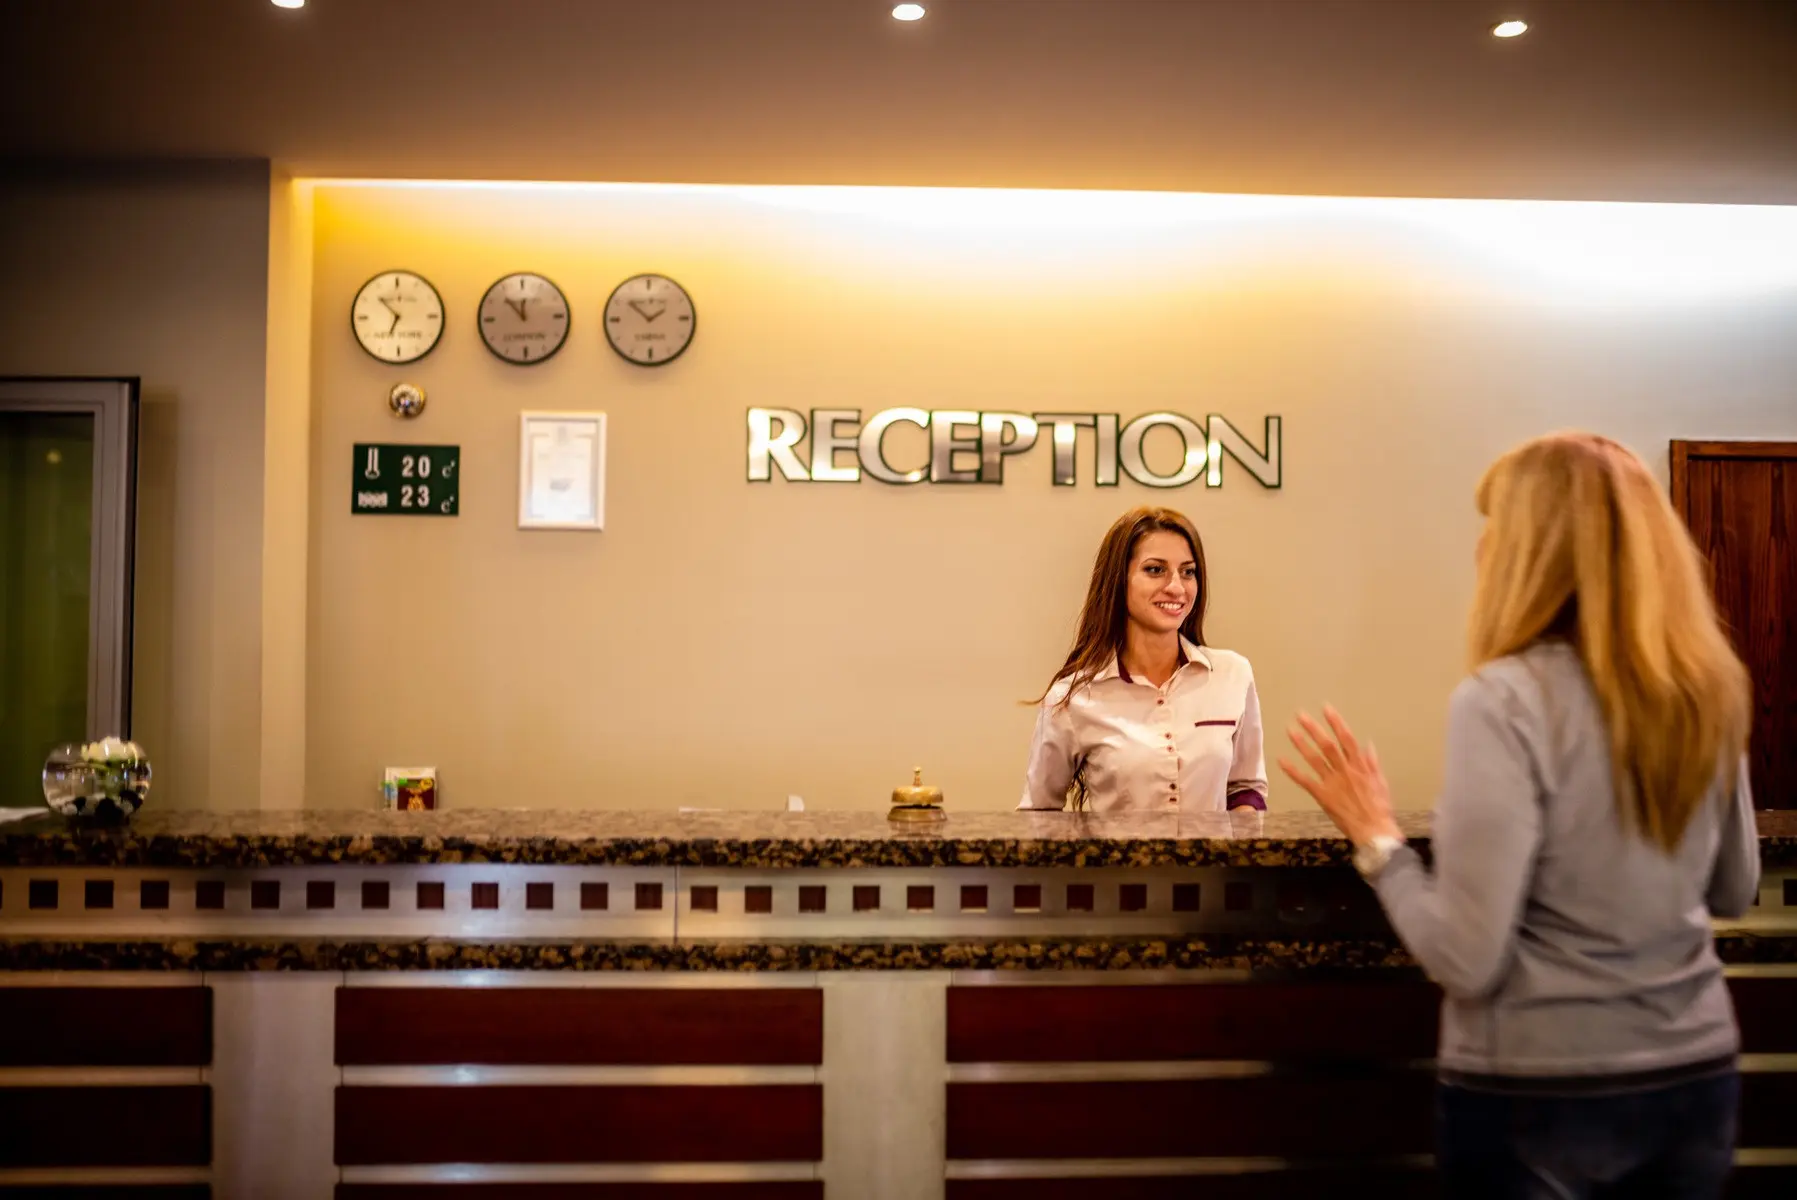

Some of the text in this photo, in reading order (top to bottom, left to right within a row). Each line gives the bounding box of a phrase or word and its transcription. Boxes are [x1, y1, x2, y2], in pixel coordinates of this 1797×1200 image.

[747, 407, 1281, 488] RECEPTION
[402, 455, 430, 478] 20
[401, 485, 429, 507] 23
